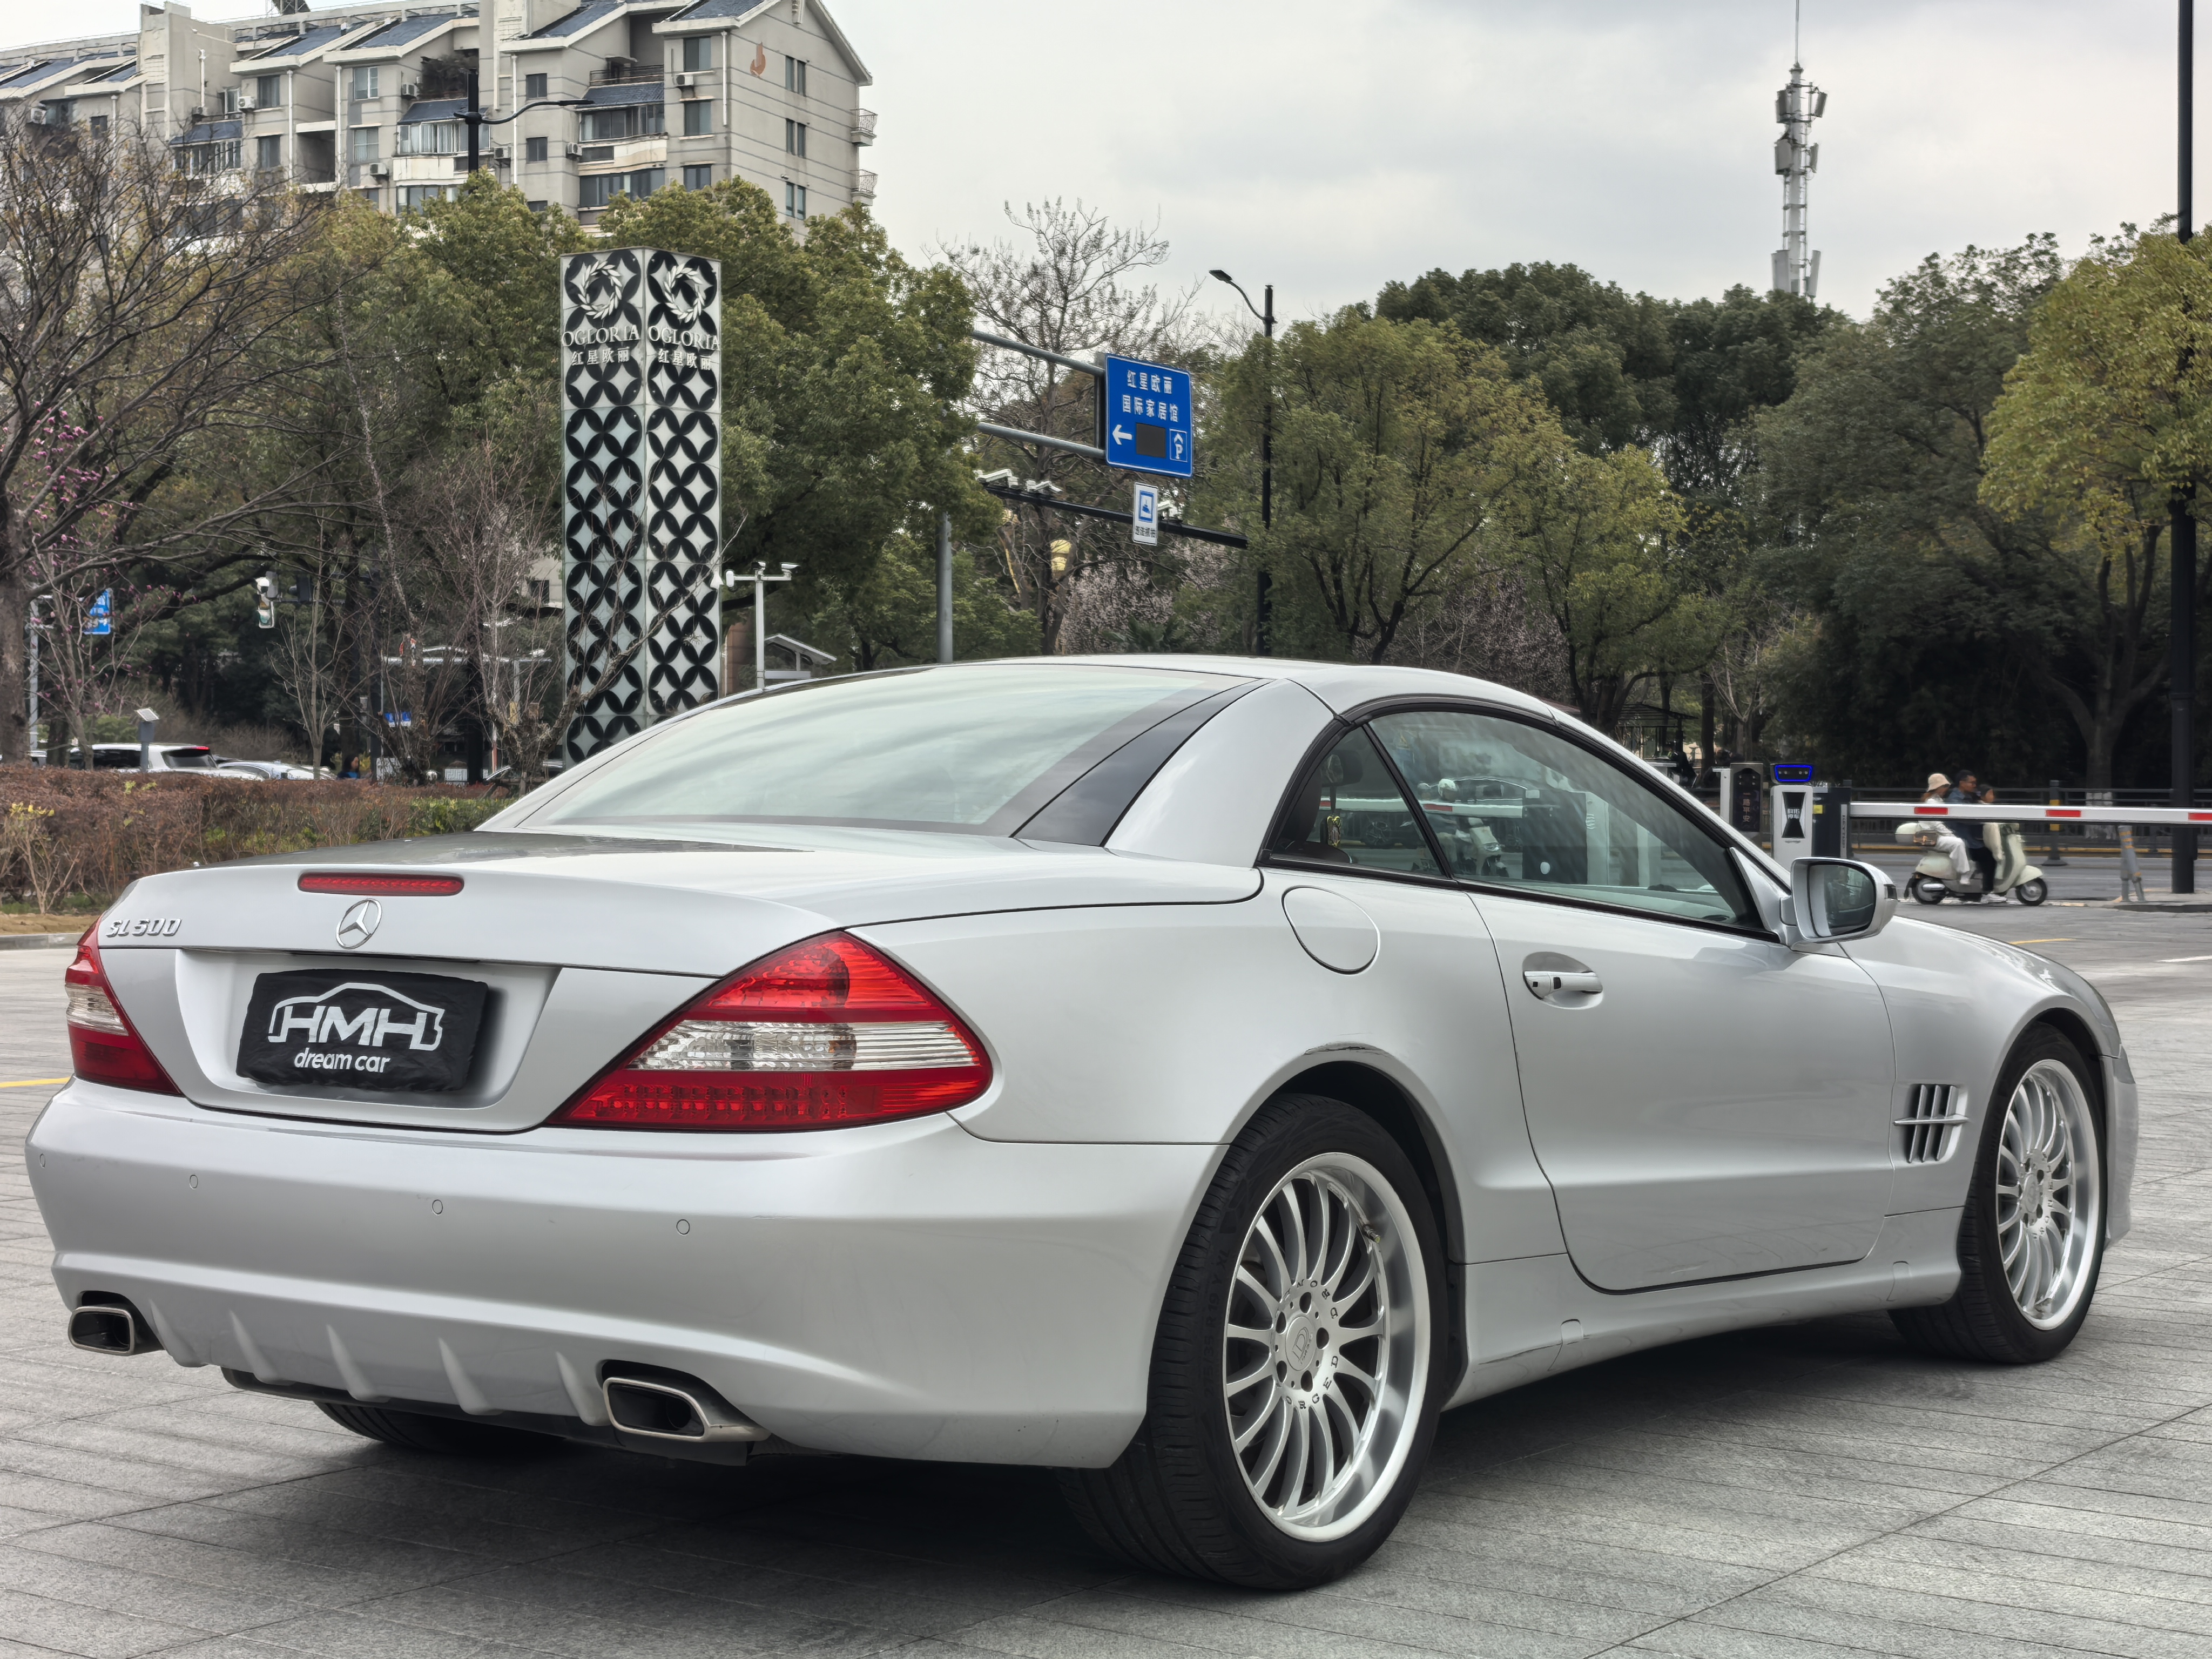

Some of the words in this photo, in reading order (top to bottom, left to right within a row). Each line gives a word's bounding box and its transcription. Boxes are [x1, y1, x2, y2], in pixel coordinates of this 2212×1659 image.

[562, 325, 640, 347] OGLORIA
[648, 326, 720, 351] OGLORIA
[571, 346, 630, 366] 红星欧丽
[658, 348, 712, 371] 红星欧丽
[1127, 369, 1172, 394] 红星欧丽
[1123, 394, 1178, 422] 国际家居馆
[273, 1005, 432, 1050] HMH
[294, 1047, 352, 1070] dream
[355, 1055, 391, 1073] car
